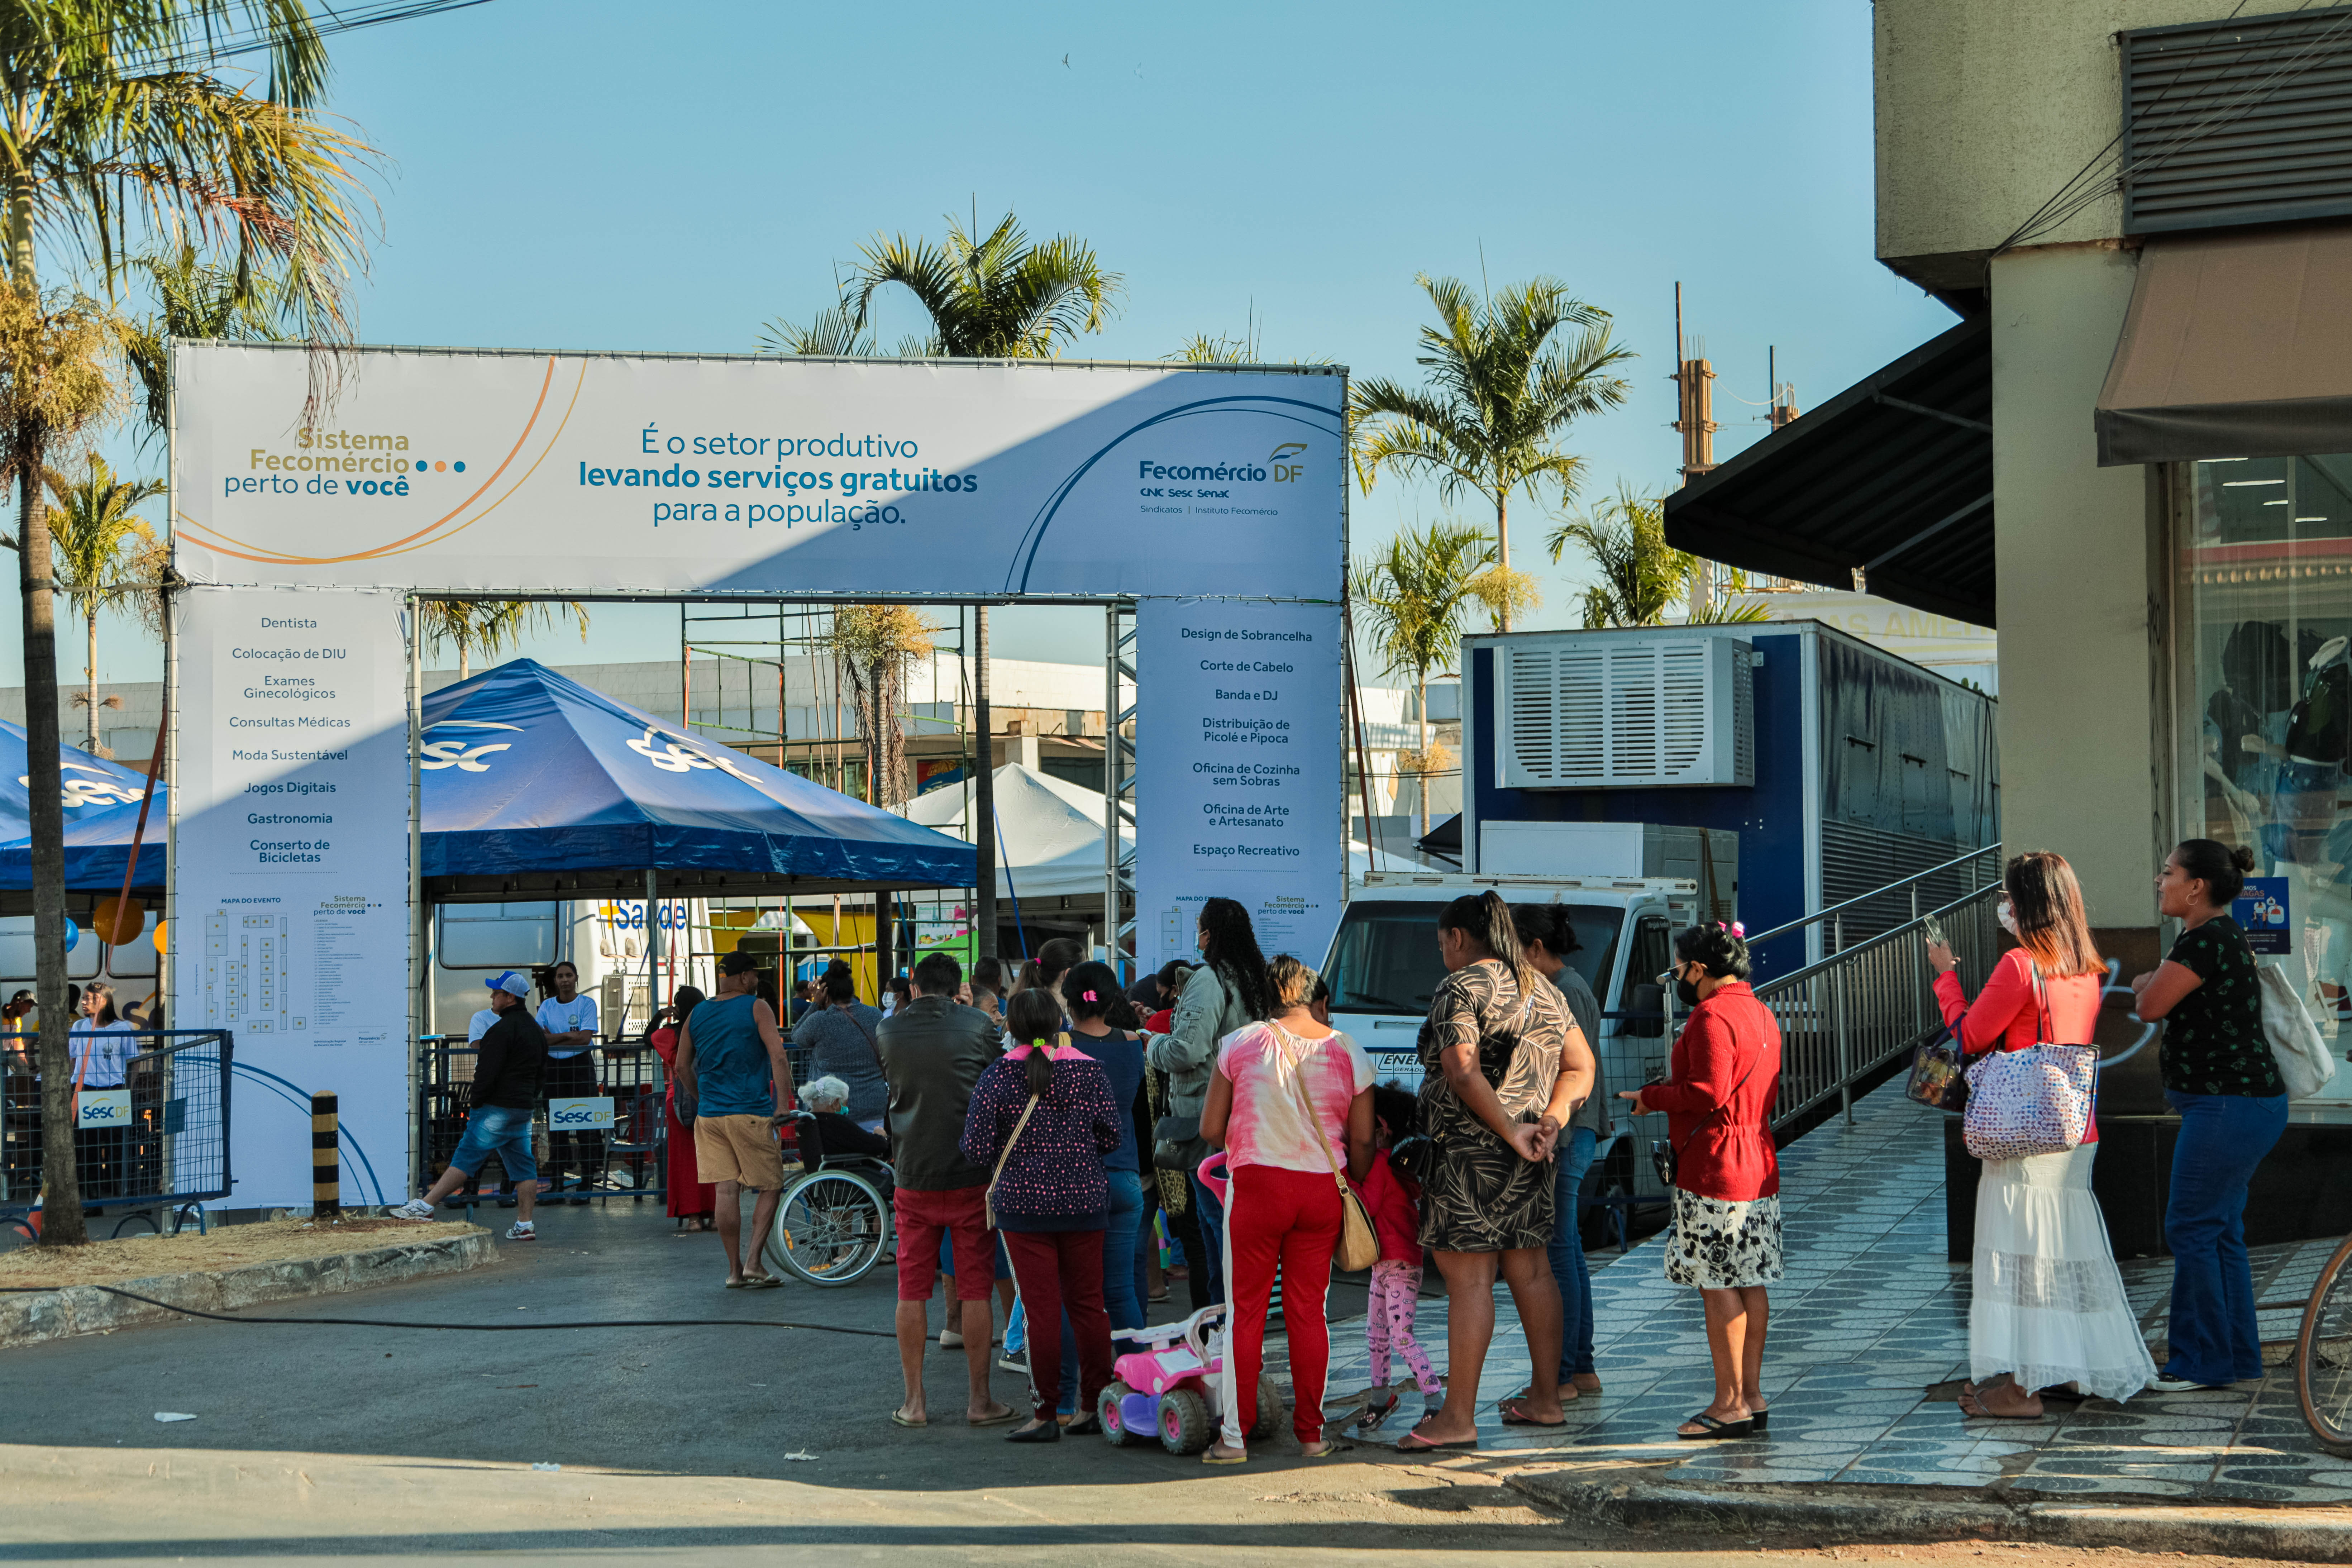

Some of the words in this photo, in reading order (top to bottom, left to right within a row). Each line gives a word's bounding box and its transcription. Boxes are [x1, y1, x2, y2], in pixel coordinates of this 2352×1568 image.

[299, 428, 409, 451] Sistema
[643, 422, 659, 454] É
[668, 438, 685, 454] o
[693, 432, 770, 456] setor
[778, 433, 918, 462] produtivo
[251, 449, 409, 473] Fecomércio
[1140, 461, 1266, 481] Fecomércio
[1274, 464, 1303, 482] DF
[225, 474, 299, 497] perto
[307, 474, 338, 495] de
[346, 475, 409, 496] você
[579, 462, 700, 487] levando
[707, 465, 833, 495] serviços
[841, 468, 978, 496] gratuitos
[1140, 488, 1164, 497] CNC
[1168, 488, 1192, 497] Sesc
[1197, 489, 1229, 498] Senac
[654, 501, 717, 526] para
[725, 505, 740, 522] a
[749, 499, 906, 530] população.
[1231, 507, 1278, 515] Fecomércio
[262, 618, 317, 628] Dentista
[1182, 628, 1221, 641] Design
[1224, 629, 1238, 639] de
[1241, 630, 1312, 642] Sobrancelha
[232, 648, 300, 662] Colocação
[304, 649, 319, 658] de
[323, 649, 346, 659] DIU
[1200, 661, 1234, 671] Corte
[1236, 661, 1250, 671] de
[1254, 662, 1293, 672] Cabelo
[265, 676, 315, 686] Exames
[244, 688, 335, 701] Ginecológicos
[1216, 690, 1251, 700] Banda
[1263, 691, 1278, 701] DJ
[229, 717, 295, 727] Consultas
[299, 717, 350, 727] Médicas
[1203, 718, 1273, 732] Distribuição
[1276, 720, 1290, 729] de
[1204, 731, 1238, 742] Picolé
[1250, 733, 1288, 745] Pipoca
[233, 750, 268, 760] Moda
[272, 749, 348, 760] Sustentável
[1193, 762, 1234, 773] Oficina
[1237, 764, 1251, 773] de
[1254, 764, 1300, 775] Cozinha
[1240, 776, 1280, 786] Sobras
[244, 783, 283, 795] Jogos
[287, 782, 336, 795] Digitais
[1203, 804, 1244, 814] Oficina
[1247, 805, 1261, 815] de
[1264, 805, 1289, 815] Arte
[248, 814, 333, 824] Gastronomia
[1219, 816, 1283, 827] Artesanato
[251, 840, 311, 850] Conserto
[314, 839, 330, 850] de
[1194, 844, 1235, 857] Espaço
[1238, 845, 1299, 856] Recreativo
[259, 852, 321, 863] Bicicletas
[616, 900, 686, 929] Sade
[83, 1106, 114, 1120] Sesc
[116, 1106, 129, 1117] DF
[554, 1111, 592, 1123] Sesc
[594, 1111, 611, 1122] DF
